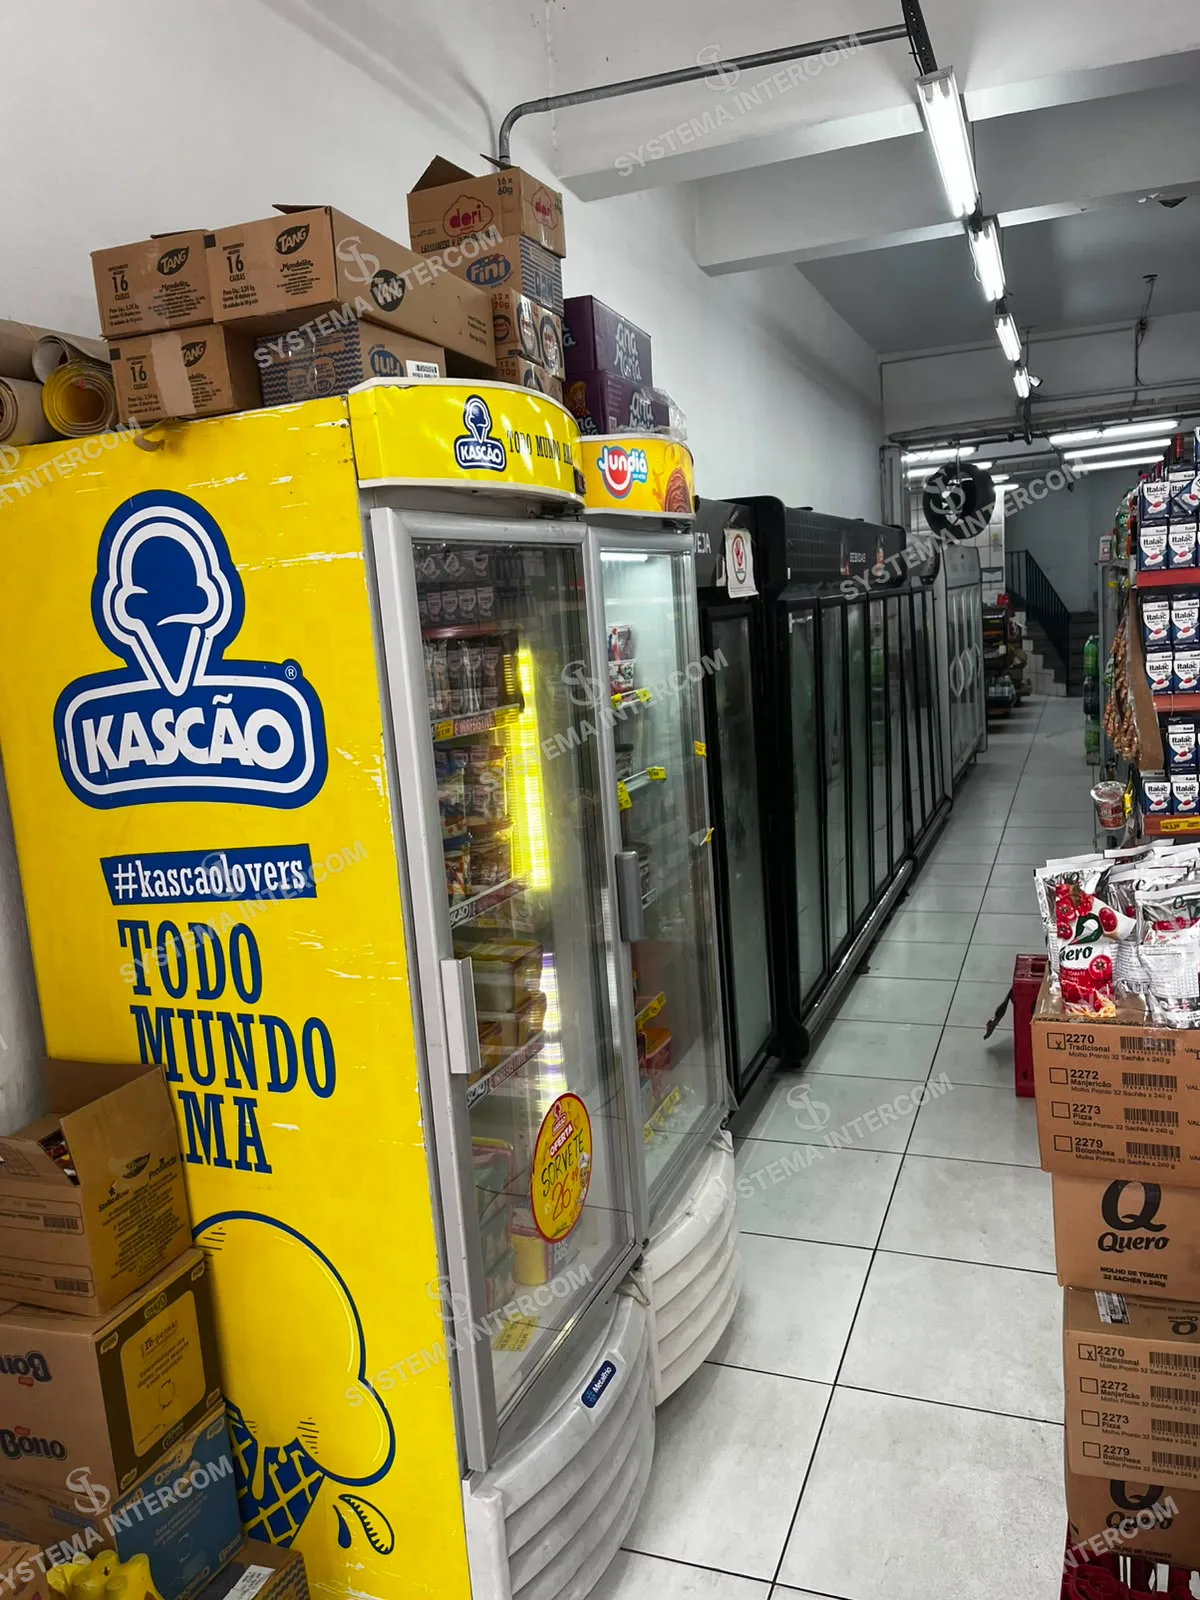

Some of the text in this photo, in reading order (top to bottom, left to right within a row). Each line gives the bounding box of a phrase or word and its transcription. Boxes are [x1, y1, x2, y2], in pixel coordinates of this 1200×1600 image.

[450, 204, 482, 228] dori
[278, 227, 307, 252] TANG
[160, 249, 187, 273] TANG
[226, 254, 244, 273] 16
[470, 256, 506, 283] Fini
[112, 273, 129, 293] 16
[182, 343, 204, 365] ANG
[130, 365, 147, 383] 16
[506, 430, 562, 462] TODO MUNDO
[459, 443, 502, 464] KASCÃO
[598, 447, 648, 475] Jundiá
[1146, 484, 1168, 493] Italac
[1143, 535, 1165, 547] Italac
[1171, 534, 1194, 544] Italac
[1146, 611, 1167, 622] Italac
[1173, 609, 1196, 620] Italac
[1148, 662, 1170, 672] Italac
[1176, 661, 1199, 671] Italac
[81, 692, 295, 774] KASCÃO
[1171, 734, 1194, 744] Italac
[1147, 783, 1168, 793] Italac
[1175, 783, 1198, 793] Italac
[112, 852, 306, 900] #kascaolovers
[1059, 945, 1094, 962] ero
[117, 918, 263, 1005] TODO
[1066, 1033, 1095, 1044] 2270
[129, 1003, 337, 1099] MUNDO
[1068, 1043, 1111, 1053] Tradicional
[1070, 1069, 1099, 1080] 2272
[1070, 1079, 1112, 1088] Manjericão
[1072, 1103, 1101, 1115] 2273
[1072, 1112, 1093, 1121] Pizza
[178, 1088, 273, 1175] MA
[1155, 1126, 1168, 1134] 240
[549, 1124, 573, 1157] OFERTA
[1074, 1137, 1103, 1149] 2279
[1075, 1147, 1115, 1157] Bolonhesa
[1101, 1179, 1167, 1232] Q
[1097, 1231, 1171, 1253] Quero
[1100, 1266, 1126, 1275] MOLHO
[1138, 1271, 1168, 1280] TOMATE
[1097, 1346, 1125, 1357] 2270
[1099, 1355, 1140, 1366] Tradicional
[1100, 1380, 1129, 1392] 2272
[1100, 1389, 1141, 1400] Manjericão
[1101, 1412, 1129, 1424] 2273
[1102, 1421, 1121, 1430] Pizza
[1102, 1444, 1130, 1456] 2279
[1103, 1453, 1141, 1464] Bolonhesa
